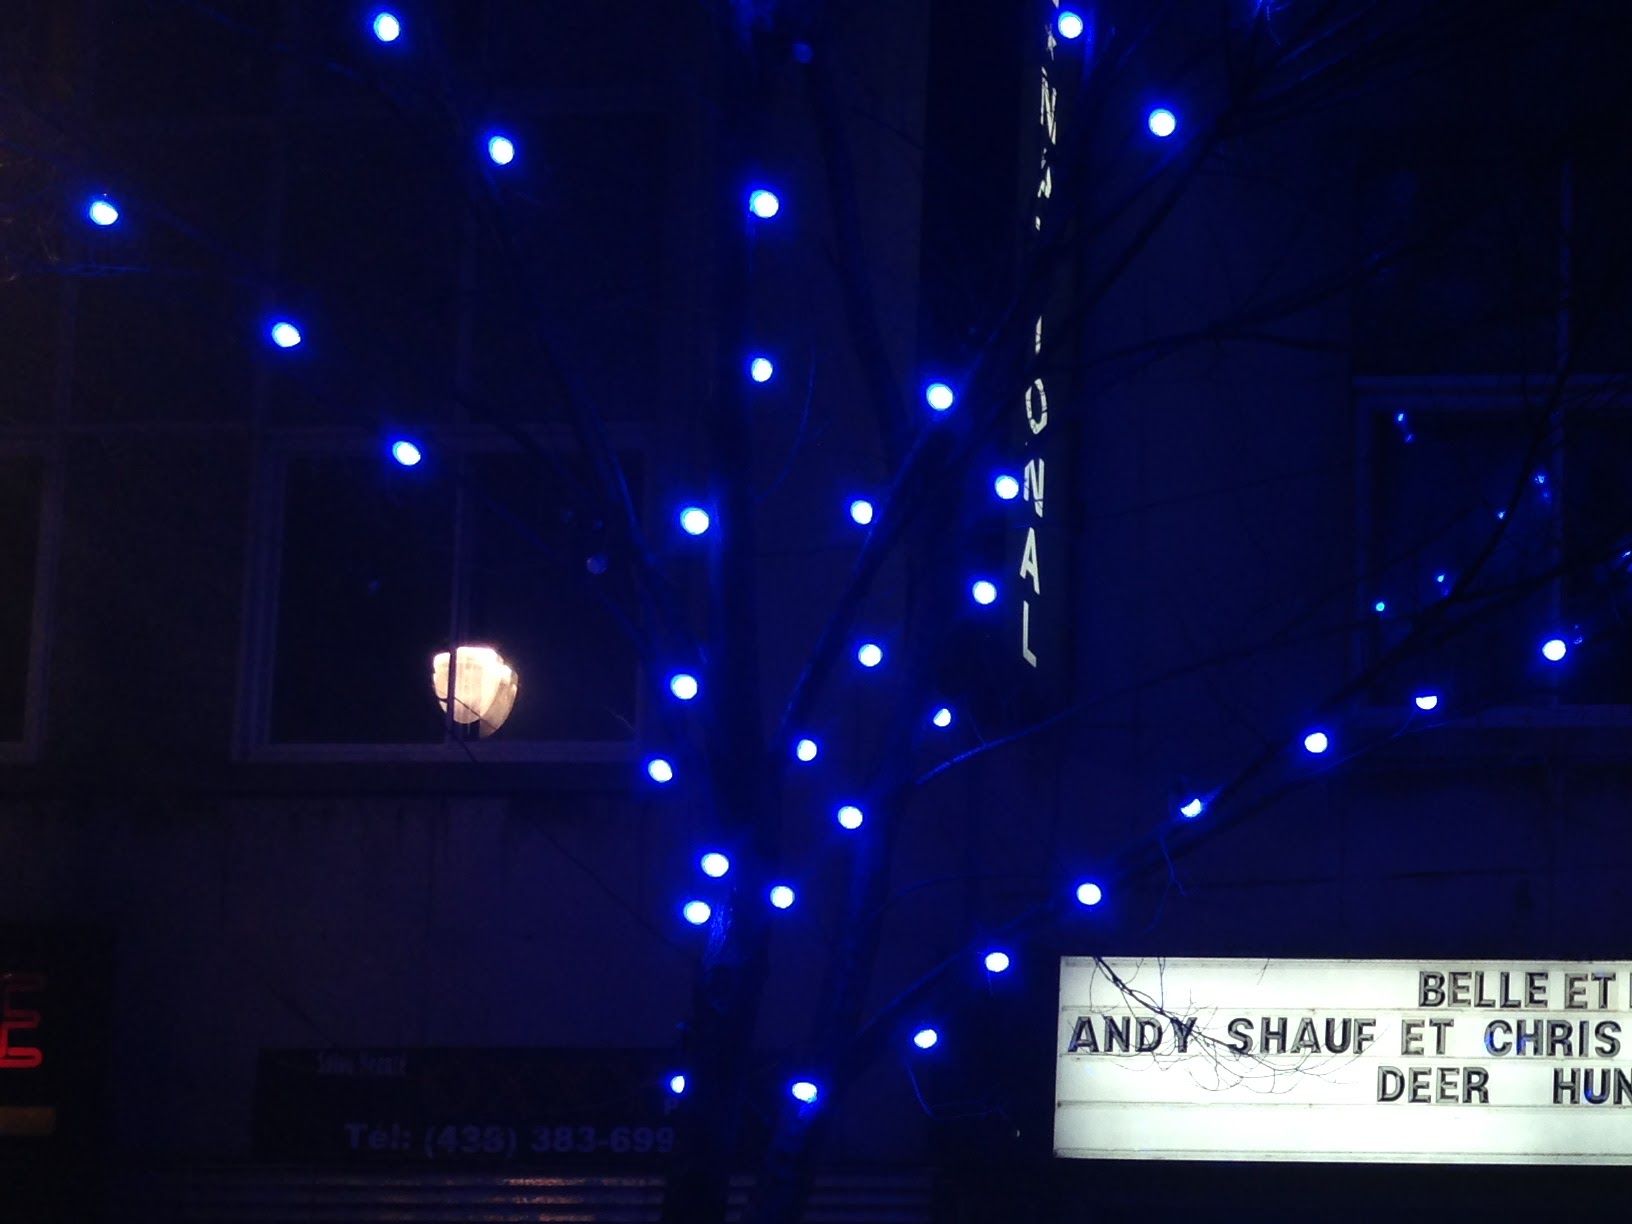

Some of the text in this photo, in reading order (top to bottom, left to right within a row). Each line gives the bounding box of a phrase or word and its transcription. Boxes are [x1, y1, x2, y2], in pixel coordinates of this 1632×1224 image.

[1418, 970, 1549, 1009] BELLE
[1564, 971, 1617, 1010] ET
[1067, 1015, 1198, 1055] ANDY
[1227, 1016, 1377, 1055] SHAUF
[1401, 1018, 1455, 1056] ET
[1483, 1018, 1622, 1058] CHRIS
[1376, 1065, 1490, 1105] DEER
[530, 1125, 677, 1153] 383-699
